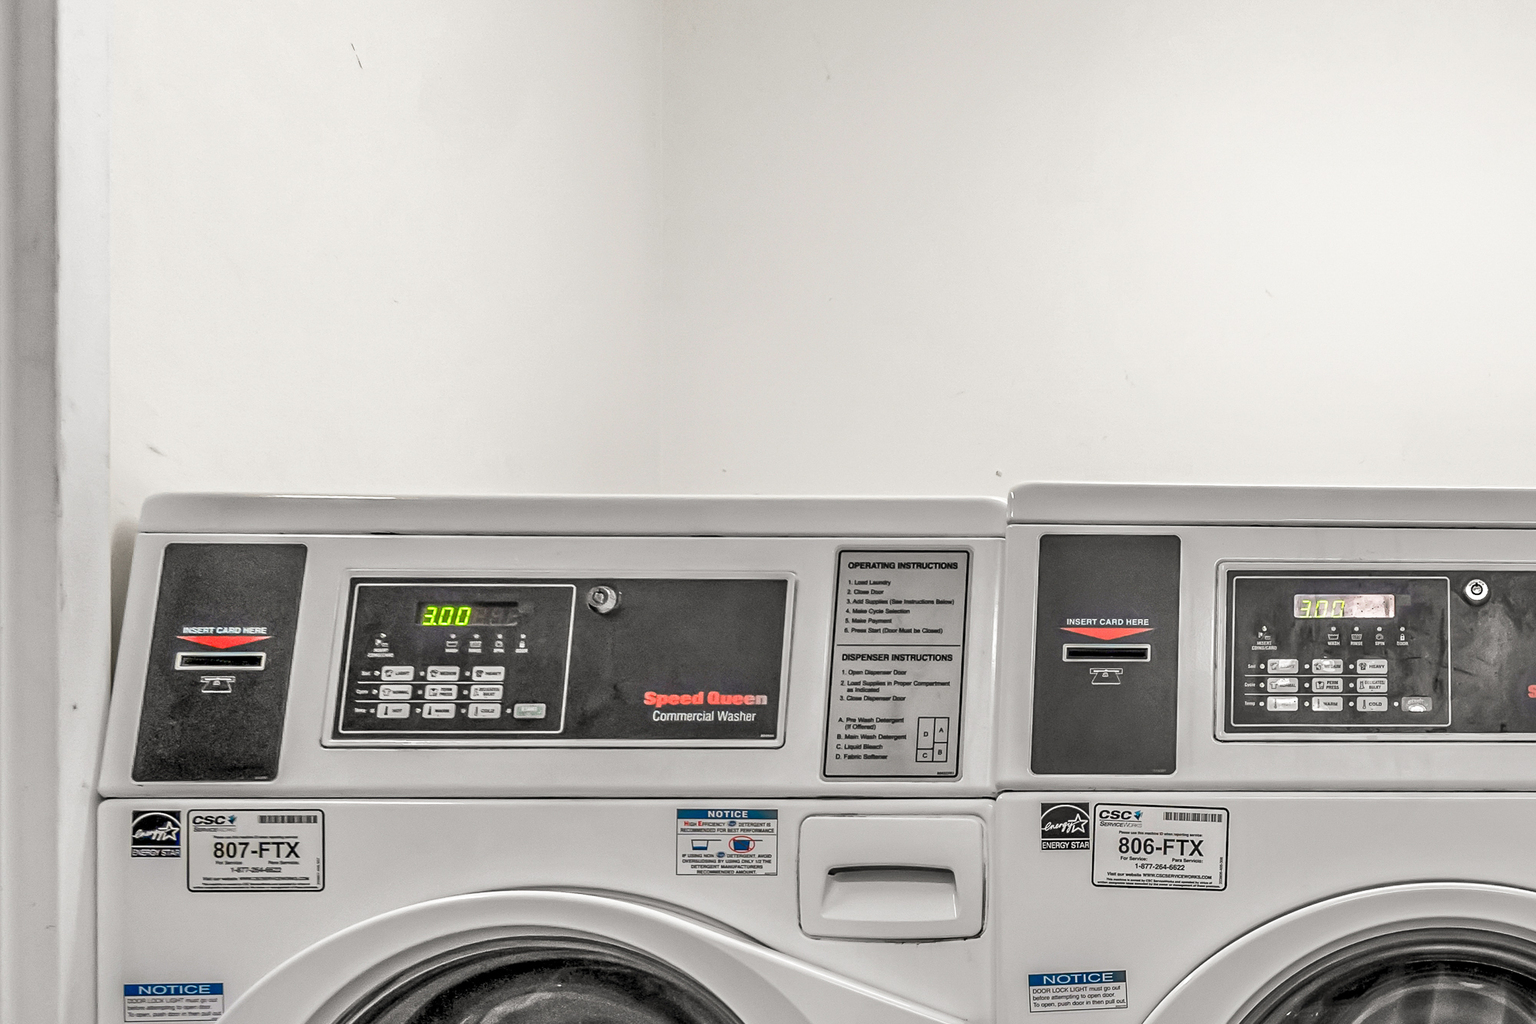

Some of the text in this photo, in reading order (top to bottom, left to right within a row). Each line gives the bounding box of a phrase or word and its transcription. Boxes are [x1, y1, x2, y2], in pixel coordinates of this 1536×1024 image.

[848, 562, 958, 570] OPERATING INSTRUCTIONS
[422, 606, 472, 626] 3.00
[1066, 618, 1149, 626] INSERT CARD HERE
[182, 626, 268, 635] INSERT CARD HERE
[643, 691, 768, 708] Speed Queen
[652, 710, 756, 721] Commercial Washer
[193, 815, 226, 825] CSC
[1099, 810, 1132, 820] CSC
[213, 842, 300, 858] 807-FTX
[1118, 837, 1204, 856] 806-FTX
[132, 849, 161, 857] ENERGY
[1043, 972, 1114, 984] NOTICE
[138, 985, 211, 995] NOTICE
